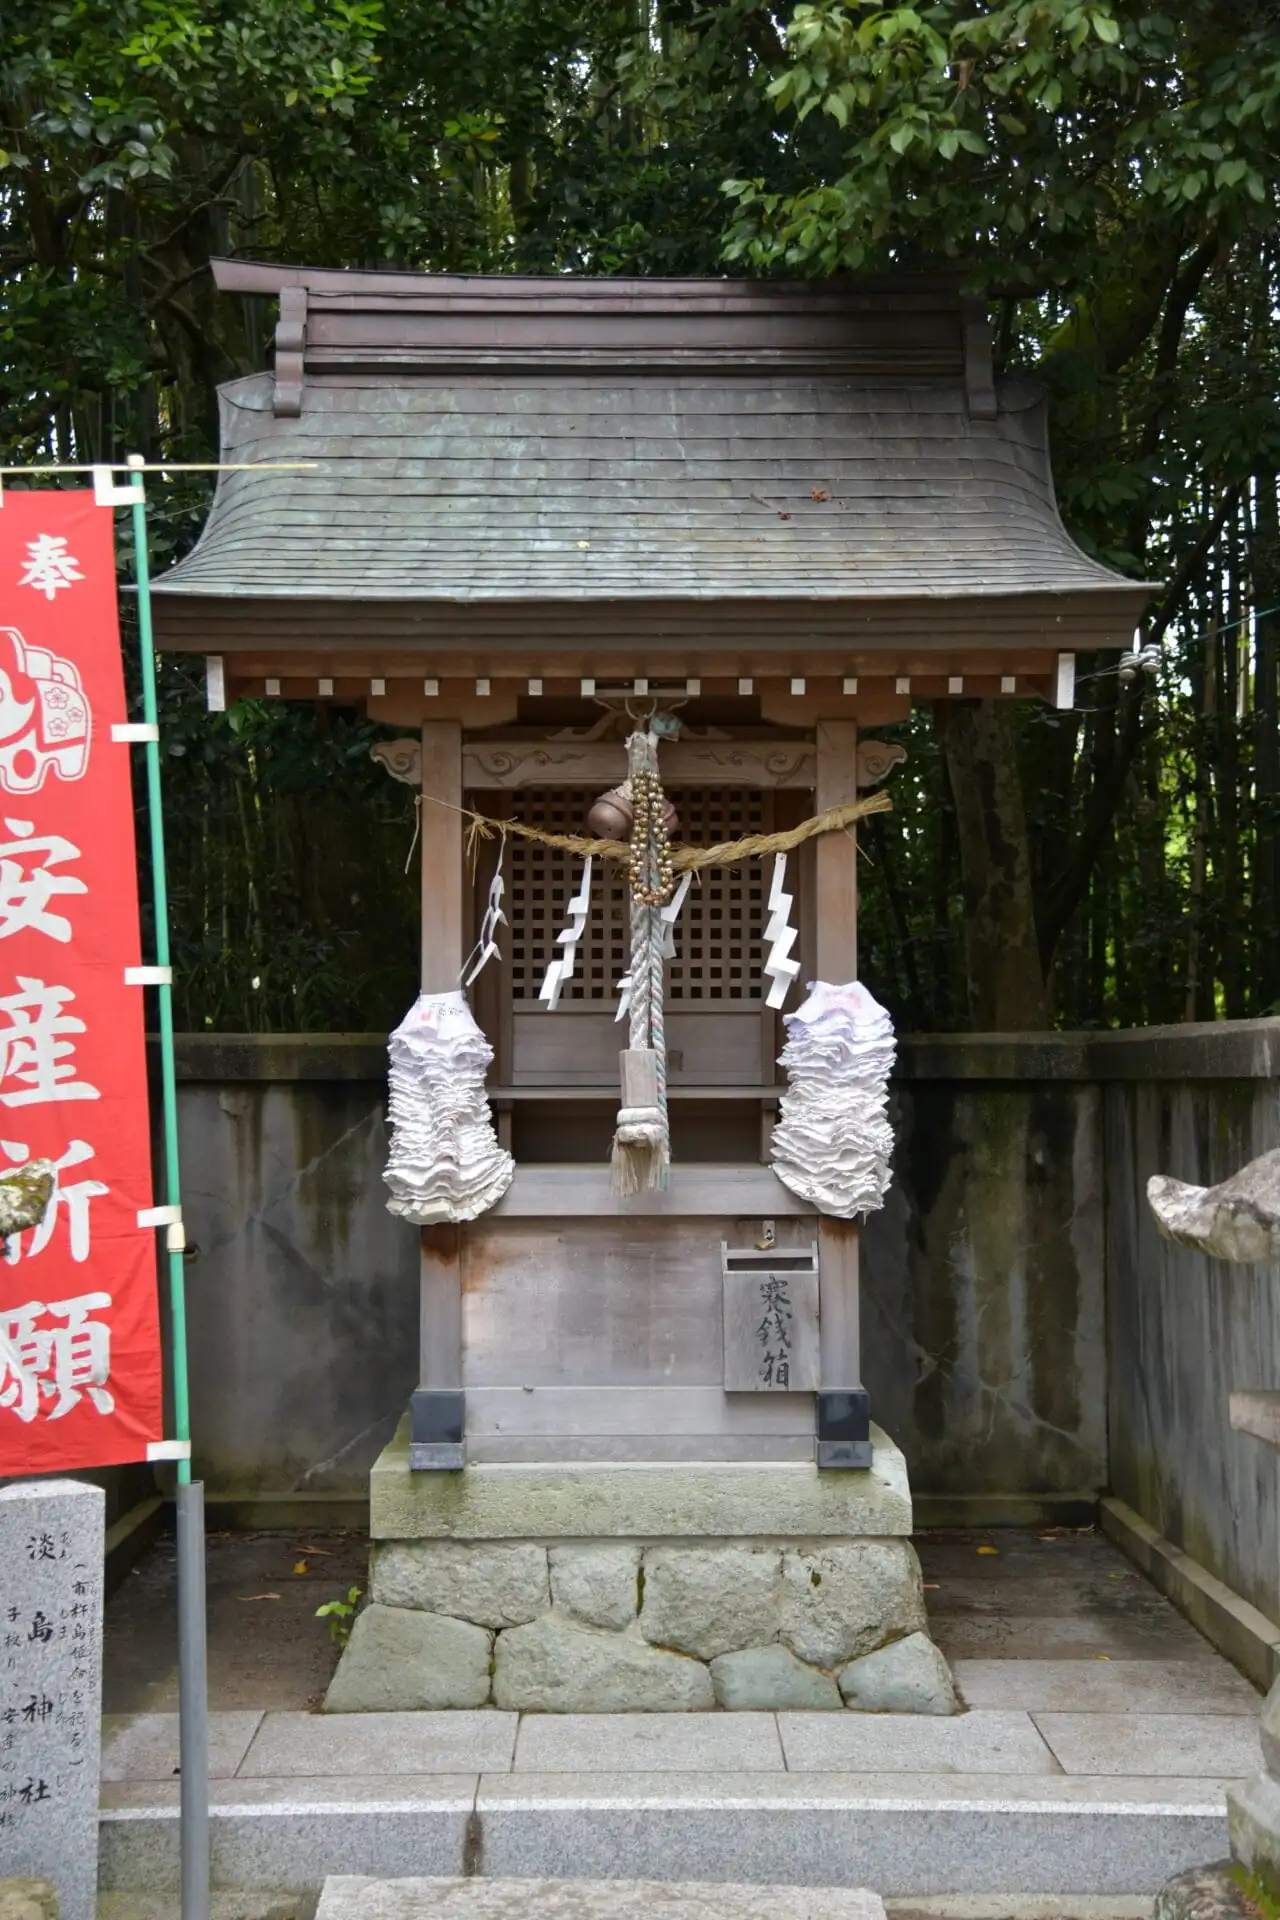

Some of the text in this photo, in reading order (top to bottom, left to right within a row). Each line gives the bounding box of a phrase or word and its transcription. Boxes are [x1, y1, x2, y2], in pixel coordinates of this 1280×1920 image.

[17, 533, 86, 601] 奉
[20, 1533, 56, 1806] 淡島神社
